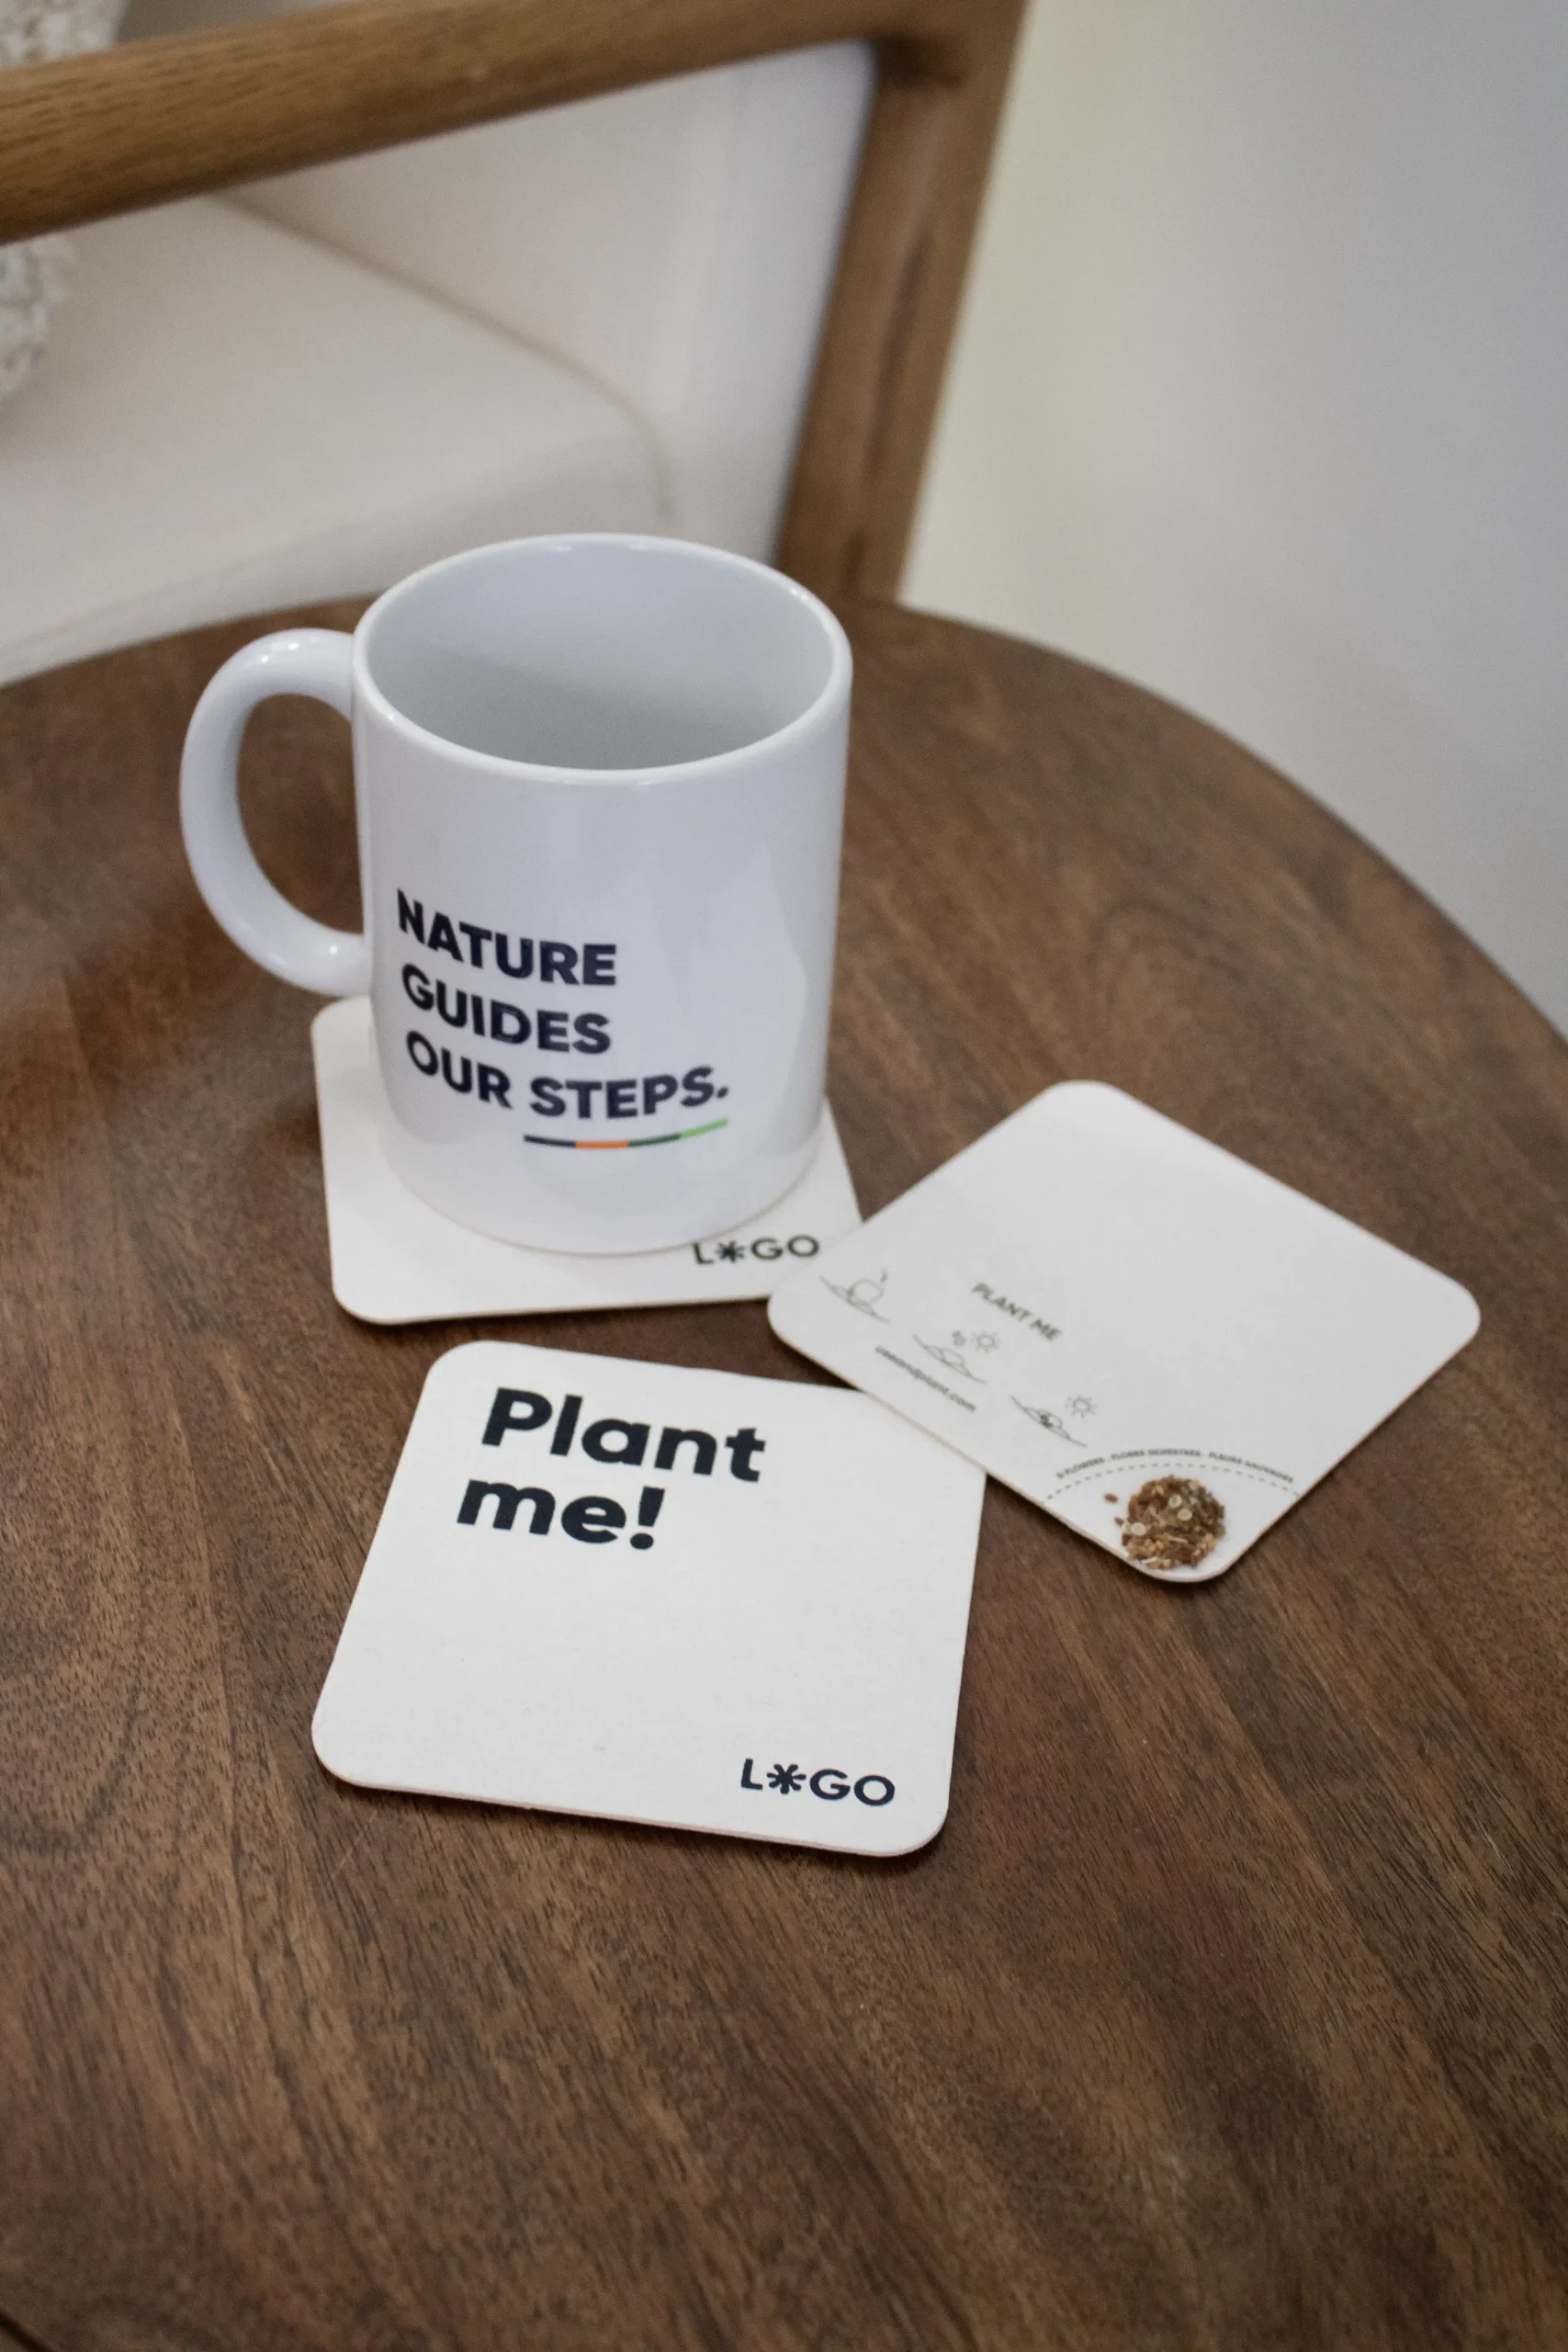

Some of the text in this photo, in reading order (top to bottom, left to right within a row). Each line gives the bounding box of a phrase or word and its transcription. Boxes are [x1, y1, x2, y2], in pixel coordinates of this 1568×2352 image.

[397, 888, 617, 986] NATURE
[401, 963, 611, 1055] GUIDES
[406, 1030, 729, 1120] OUR STEPS.
[972, 1283, 1064, 1342] PLANT ME
[481, 1387, 767, 1483] Plant
[457, 1478, 666, 1551] me!
